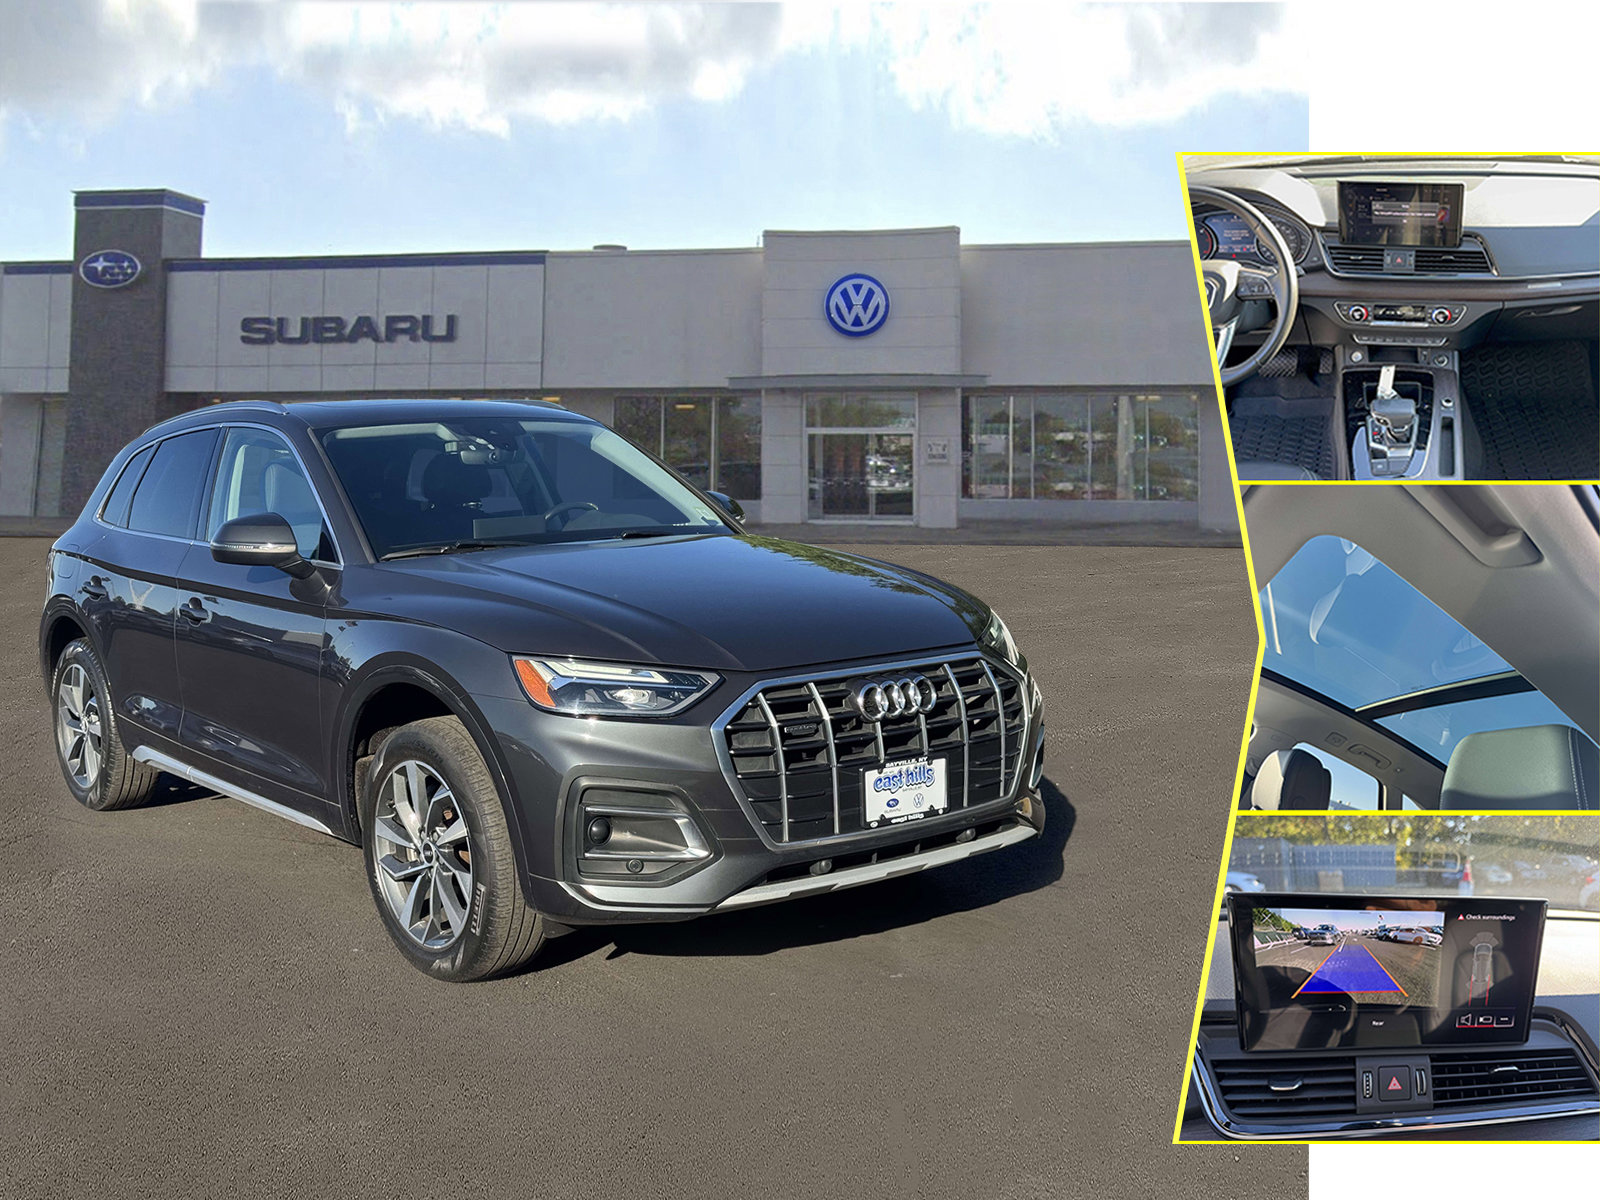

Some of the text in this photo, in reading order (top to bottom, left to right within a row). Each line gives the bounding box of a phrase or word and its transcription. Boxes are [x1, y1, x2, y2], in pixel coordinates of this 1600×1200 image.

[240, 314, 457, 345] SUBARU
[874, 764, 935, 794] east hills
[1465, 913, 1516, 922] Check surroundings
